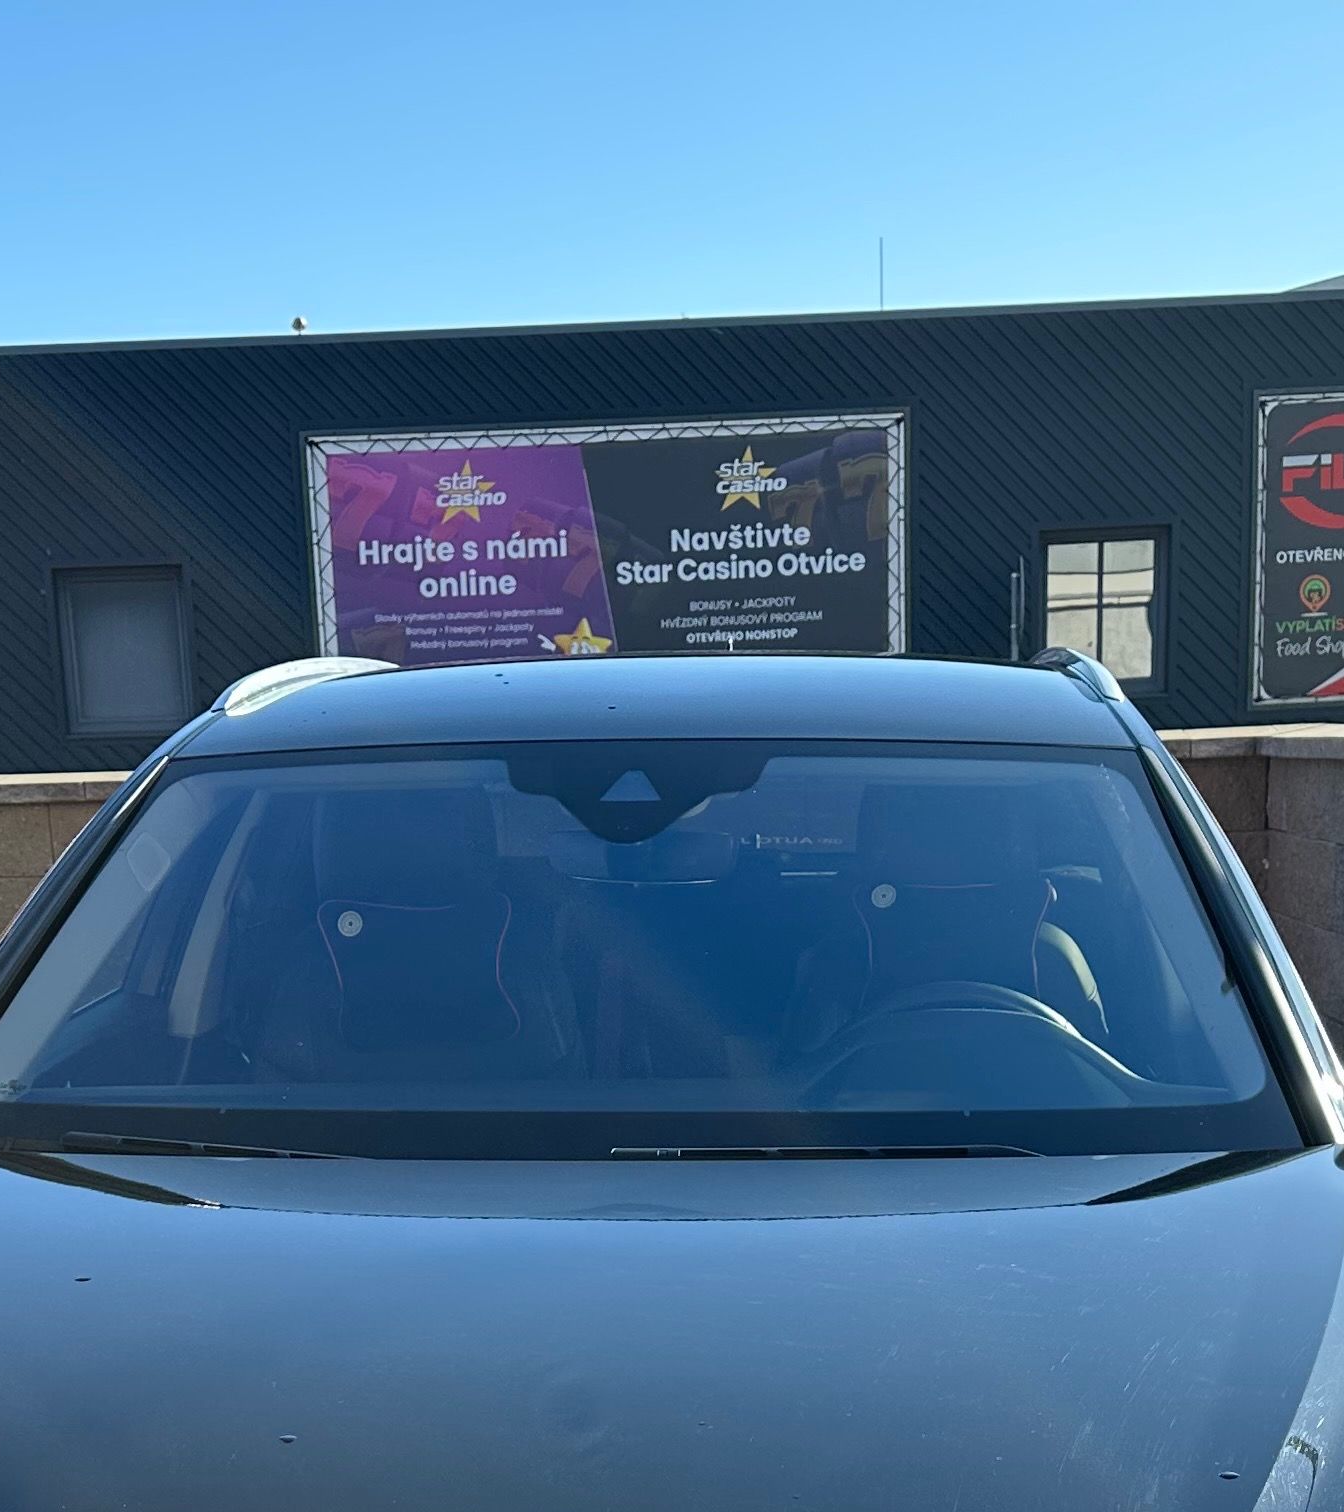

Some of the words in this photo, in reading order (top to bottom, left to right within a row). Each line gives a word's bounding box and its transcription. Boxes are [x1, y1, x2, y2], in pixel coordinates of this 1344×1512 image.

[719, 458, 765, 478] star
[438, 471, 484, 491] star
[716, 475, 787, 494] casino
[435, 490, 506, 508] casino
[670, 523, 811, 552] Navštivte
[358, 535, 455, 571] Hrajte
[462, 541, 479, 561] s
[486, 529, 567, 560] námi
[616, 560, 673, 585] Star
[676, 554, 773, 582] Casino
[777, 548, 866, 576] Otvice
[419, 569, 517, 598] online
[689, 599, 732, 611] BONUSY
[741, 596, 796, 609] JACKPOTY
[769, 609, 823, 624] PROGRAM
[745, 627, 798, 640] NONSTOP
[1276, 637, 1311, 657] Food
